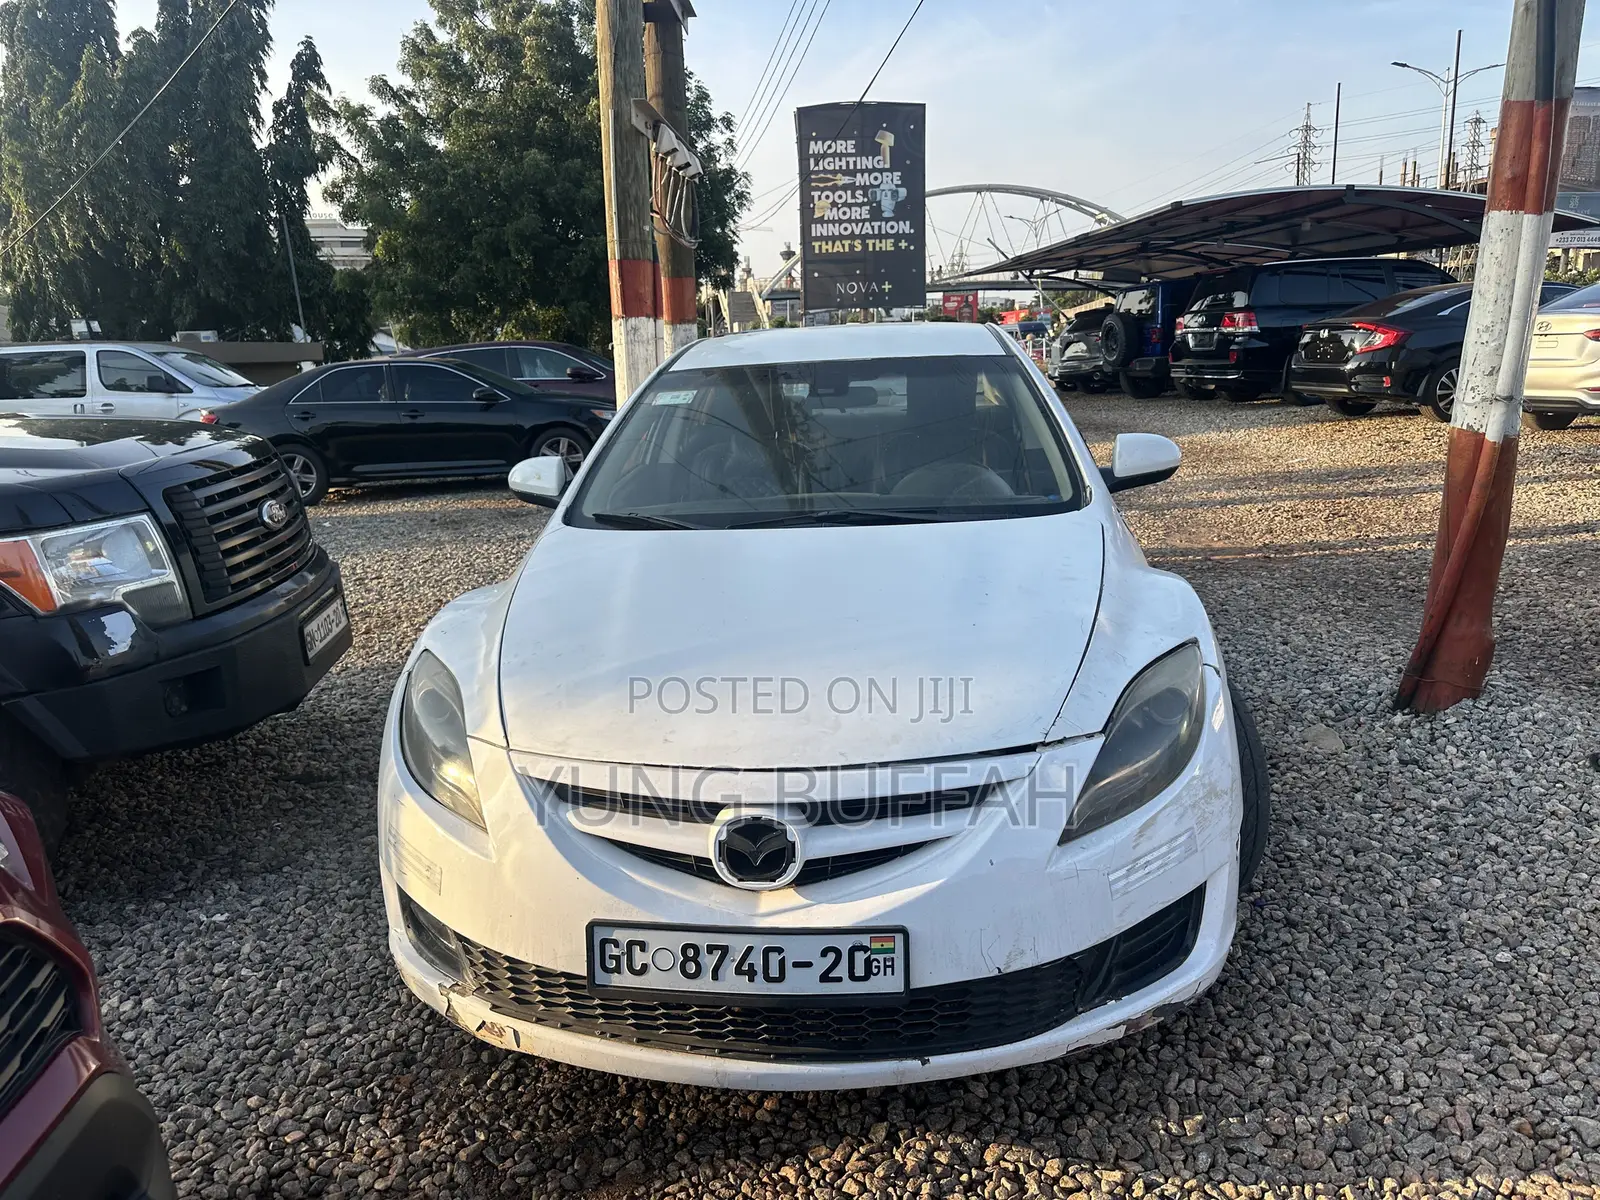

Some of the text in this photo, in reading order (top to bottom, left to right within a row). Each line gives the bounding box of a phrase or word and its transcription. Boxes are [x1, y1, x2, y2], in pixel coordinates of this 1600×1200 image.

[809, 140, 856, 154] MORE
[855, 172, 902, 187] MORE
[811, 190, 868, 204] TOOLS.
[824, 206, 870, 220] MORE
[811, 221, 915, 237] INNOVATION.
[812, 239, 862, 253] THAT'S
[866, 239, 895, 251] THE
[599, 937, 648, 976] GC
[870, 957, 895, 977] GH
